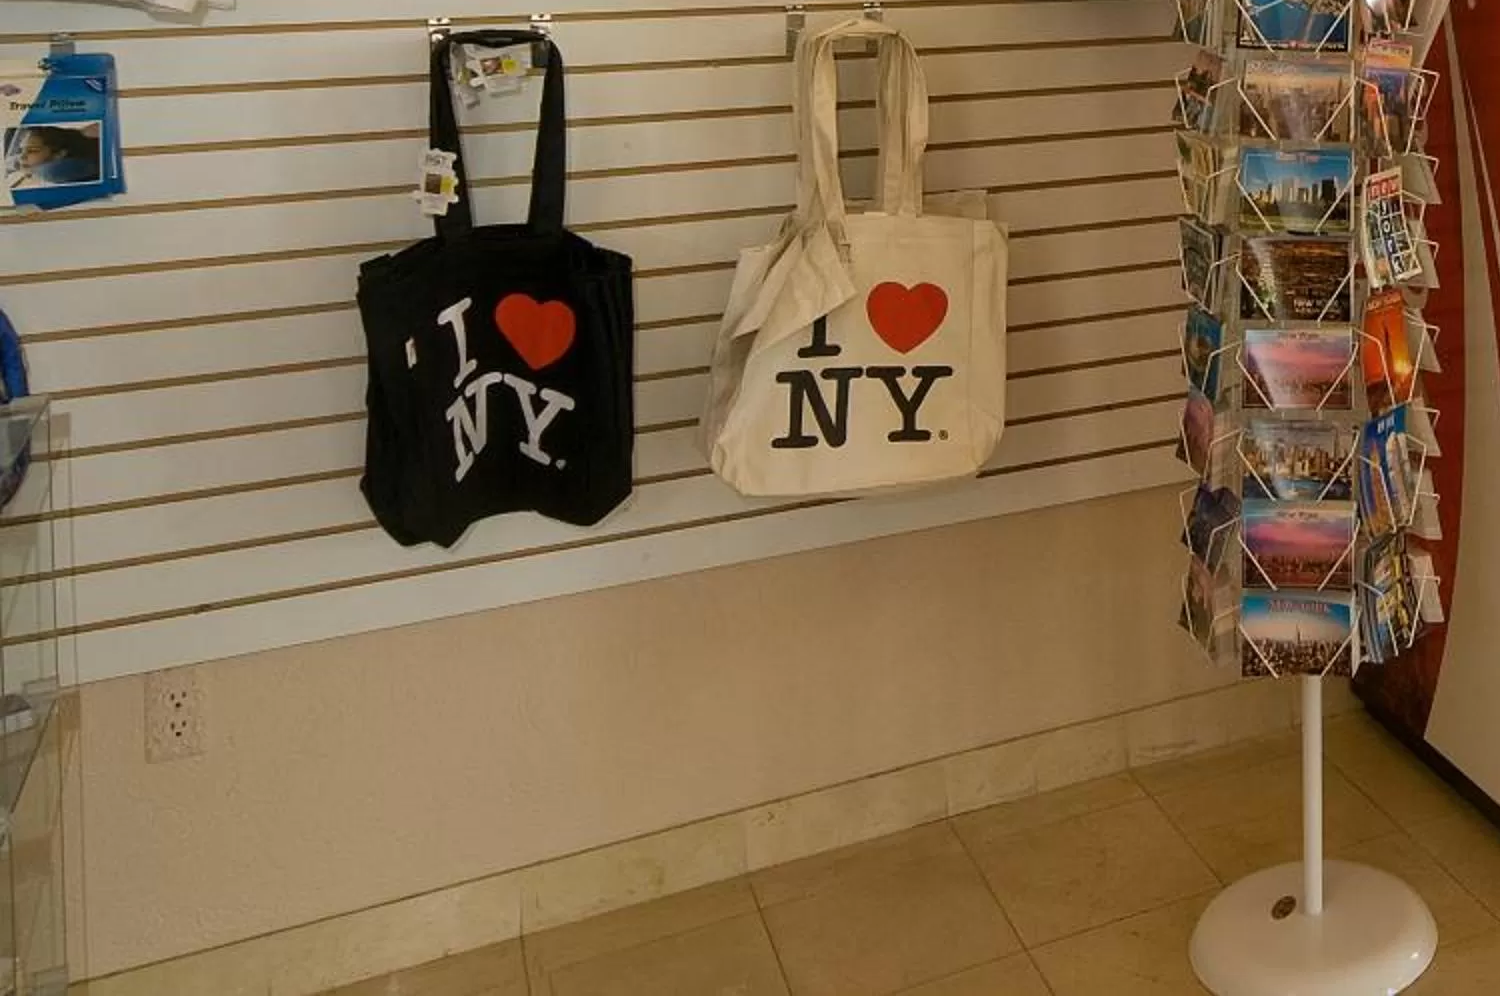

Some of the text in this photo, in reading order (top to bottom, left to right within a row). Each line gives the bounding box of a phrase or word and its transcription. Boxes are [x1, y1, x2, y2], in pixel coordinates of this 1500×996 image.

[436, 297, 471, 388] I
[444, 370, 576, 483] NY
[771, 365, 953, 450] NY
